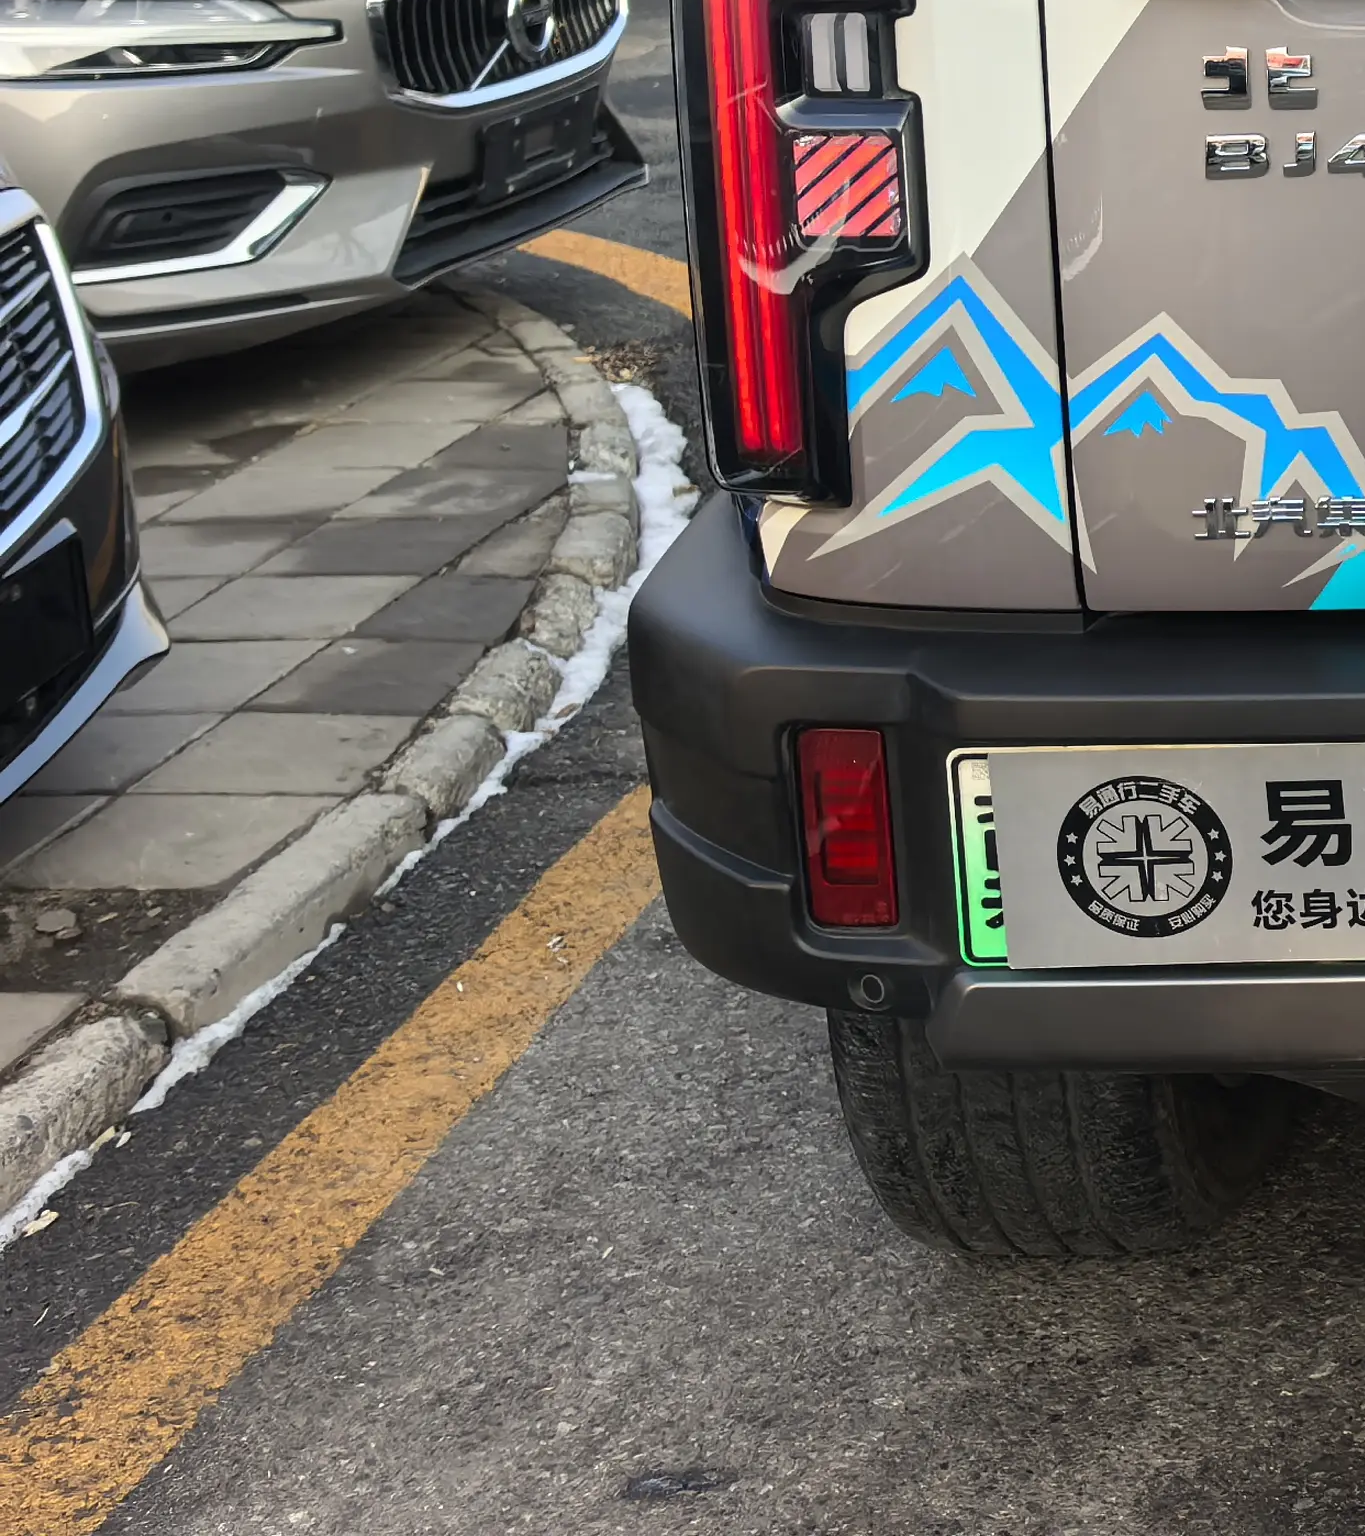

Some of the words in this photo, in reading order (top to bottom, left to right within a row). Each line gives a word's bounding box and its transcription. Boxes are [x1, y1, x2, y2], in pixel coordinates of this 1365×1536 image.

[1079, 781, 1203, 819] 易通行二手车
